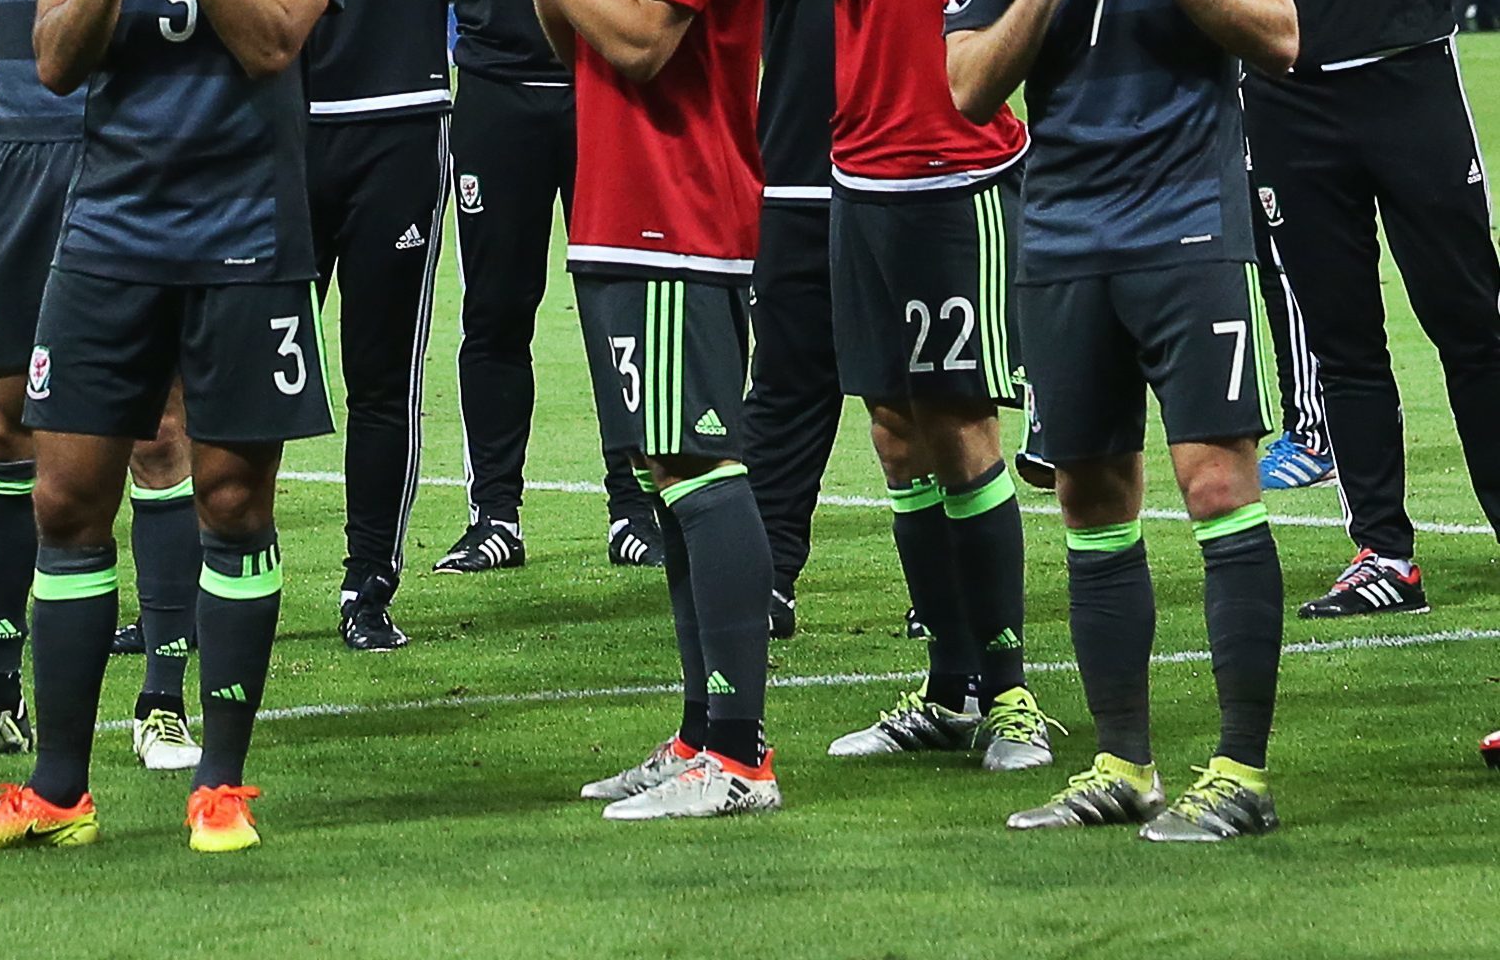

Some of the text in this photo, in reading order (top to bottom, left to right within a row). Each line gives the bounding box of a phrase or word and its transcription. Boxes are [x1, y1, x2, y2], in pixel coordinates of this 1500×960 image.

[395, 238, 426, 250] adidas
[269, 315, 307, 396] 3
[906, 296, 977, 373] 22
[1212, 320, 1246, 401] 7
